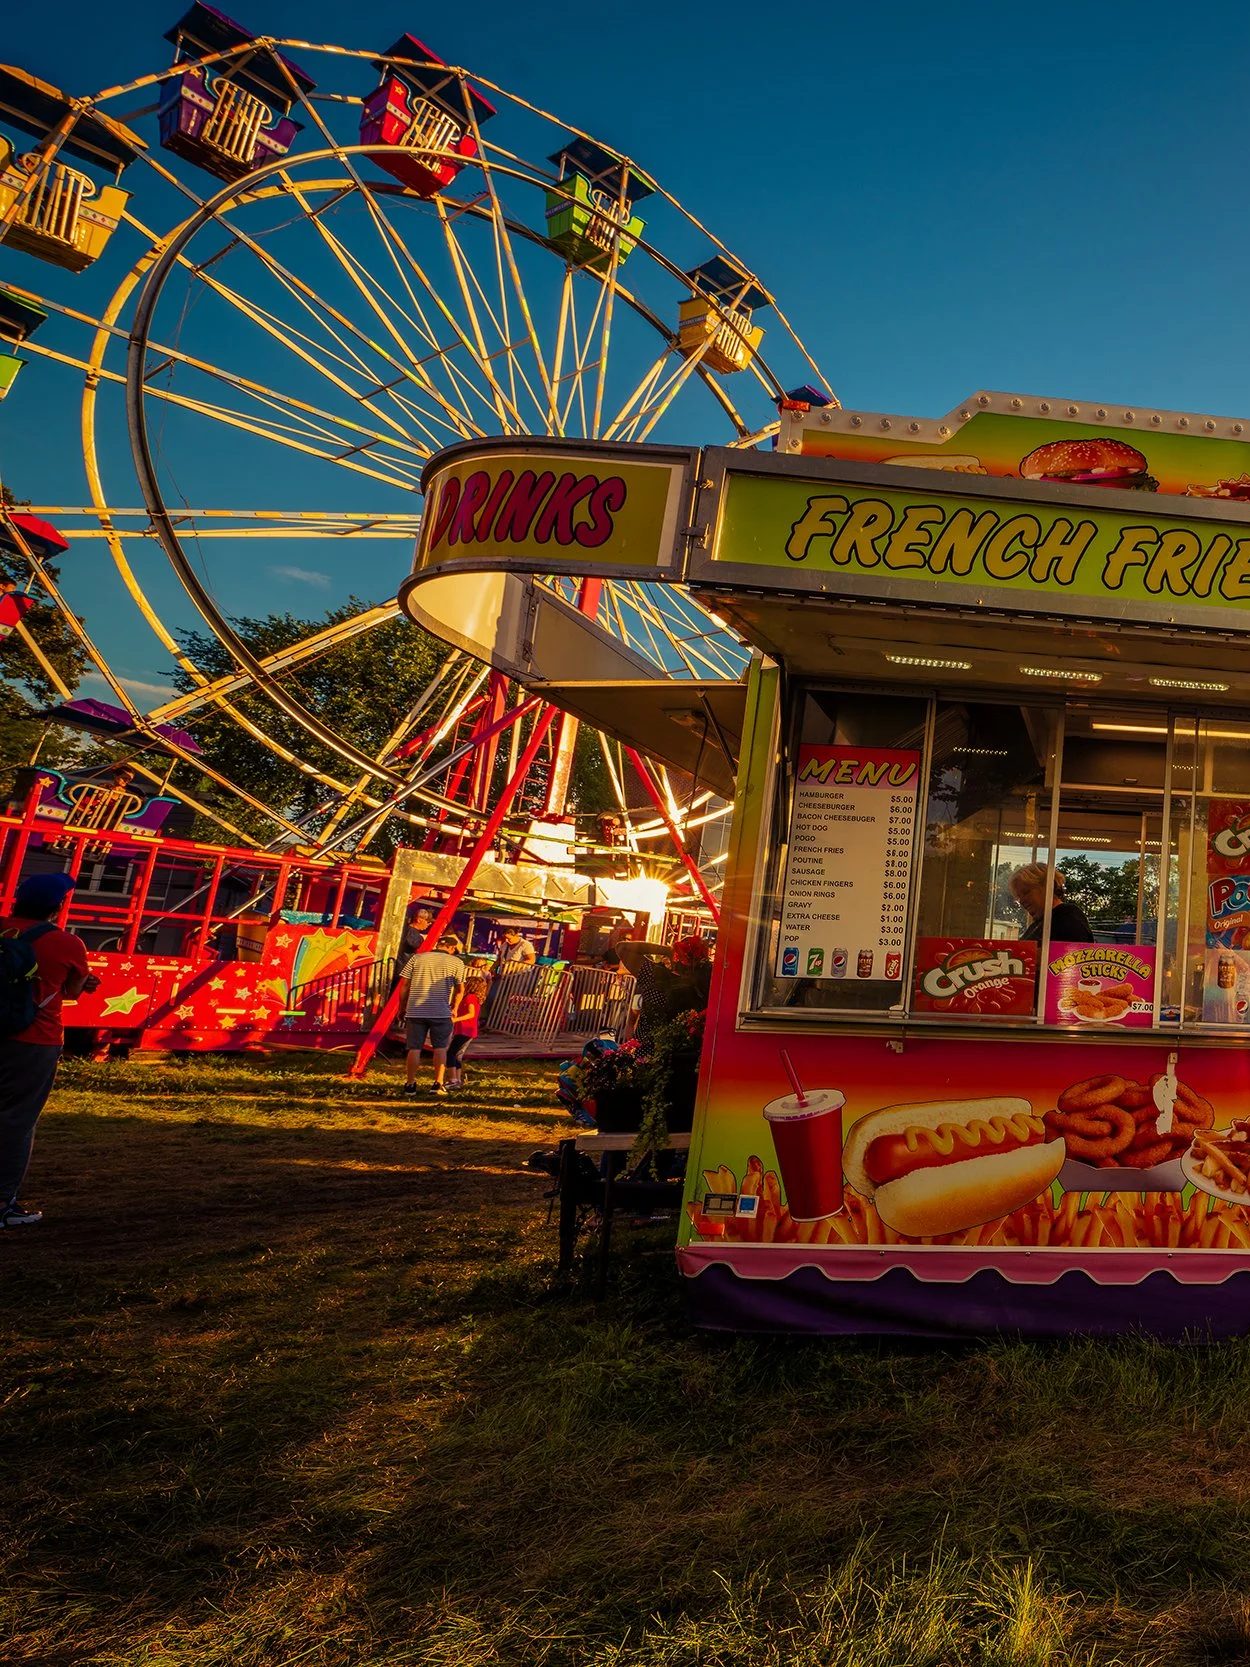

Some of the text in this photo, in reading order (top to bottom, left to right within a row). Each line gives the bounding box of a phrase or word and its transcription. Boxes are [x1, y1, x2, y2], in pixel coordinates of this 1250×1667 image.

[428, 469, 627, 552] DRINKS
[785, 494, 1099, 586] FRENCH
[798, 757, 917, 787] MENU
[799, 791, 913, 804] HAMBURGER $5.00
[798, 802, 913, 814] CHEESEBURGER $6.00
[823, 814, 876, 823] CHEESEBUGER
[888, 816, 911, 825] $7.00
[812, 824, 828, 832] DOG
[888, 827, 911, 835] $5.00
[794, 834, 910, 846] POGO $5.00
[792, 856, 824, 865] POUTINE
[791, 867, 908, 878] SAUSAGE $8.00
[790, 879, 906, 890] CHICKEN FINGERS $6.00
[883, 892, 906, 900] $6.00
[787, 901, 905, 912] GRAVY $2.00
[786, 912, 904, 923] EXTRA CHEESE $1.00
[1214, 914, 1244, 930] Original
[785, 923, 904, 934] WATER $3.00
[878, 938, 902, 946] $3.00
[1049, 947, 1152, 980] MOZZARELLA
[921, 951, 1024, 999] Crush
[1080, 962, 1128, 982] STICKS
[963, 977, 1010, 999] Orange
[1132, 1003, 1154, 1012] $7.00
